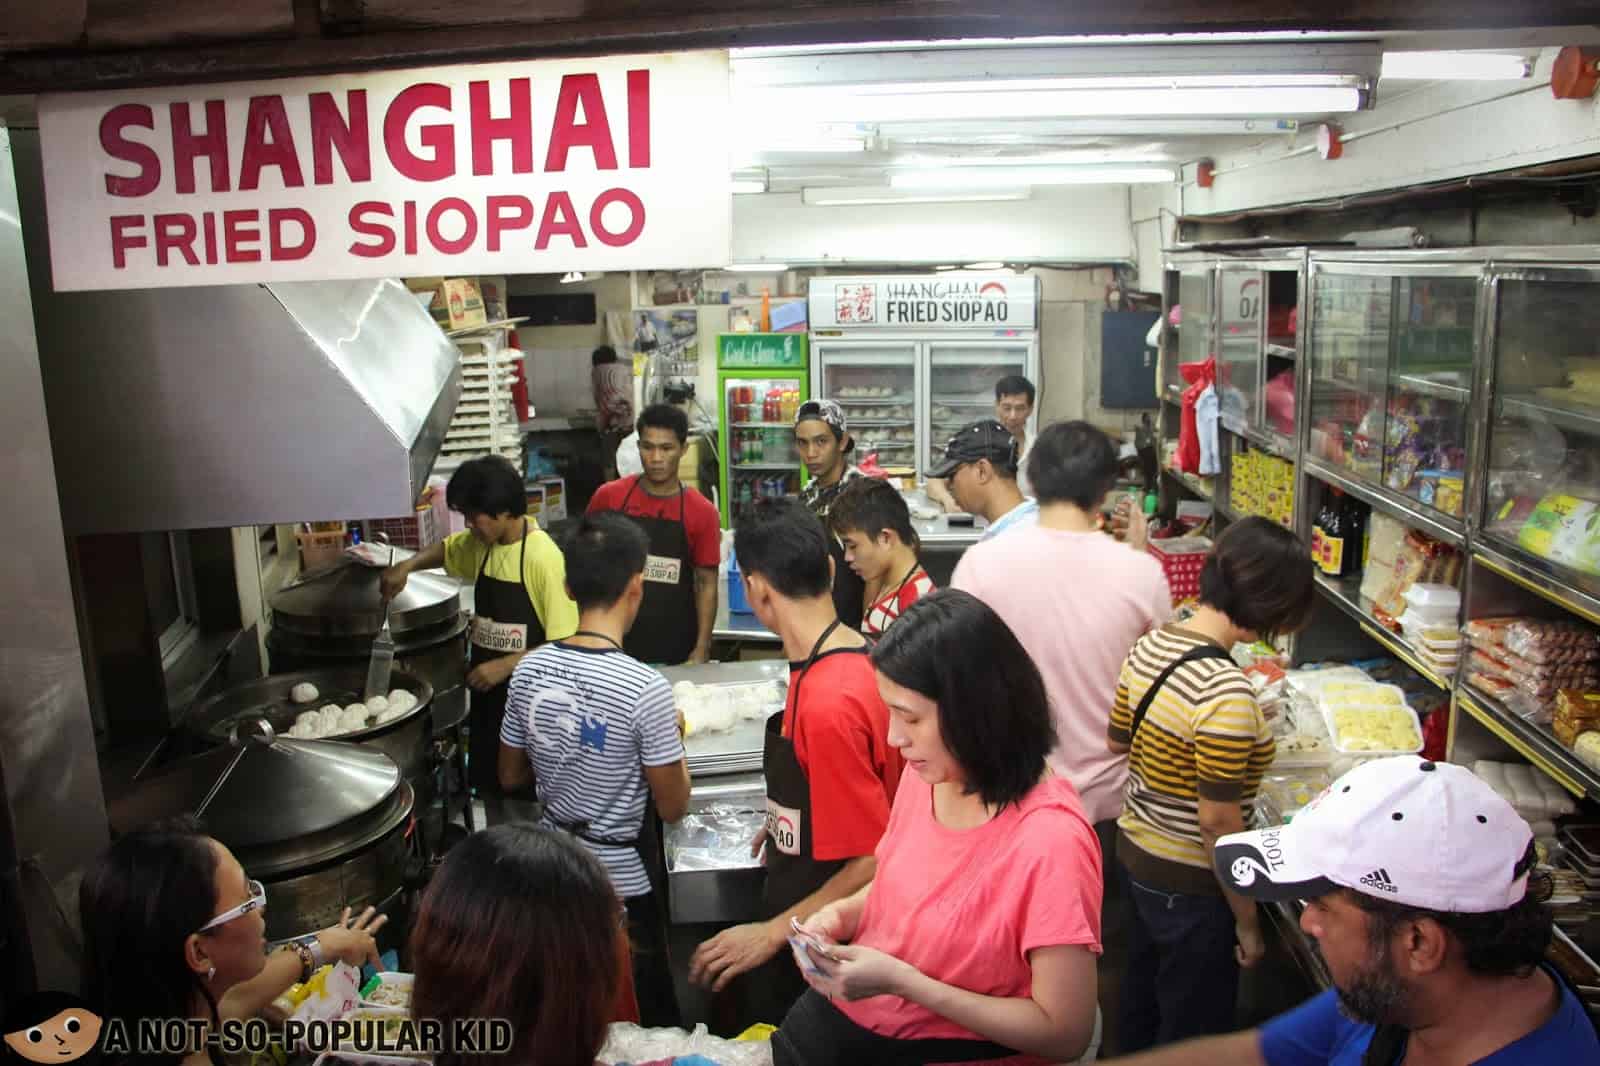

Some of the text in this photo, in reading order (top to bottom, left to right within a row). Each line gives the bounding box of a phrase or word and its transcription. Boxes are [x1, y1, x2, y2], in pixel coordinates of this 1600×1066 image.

[98, 69, 650, 198] SHANGHAI
[110, 187, 646, 269] FRIED SIOPAO
[887, 281, 978, 299] SHANGHAI
[887, 301, 1008, 323] FRIED SIOPAO
[493, 636, 522, 649] SIOPAO
[1359, 875, 1399, 893] adidas
